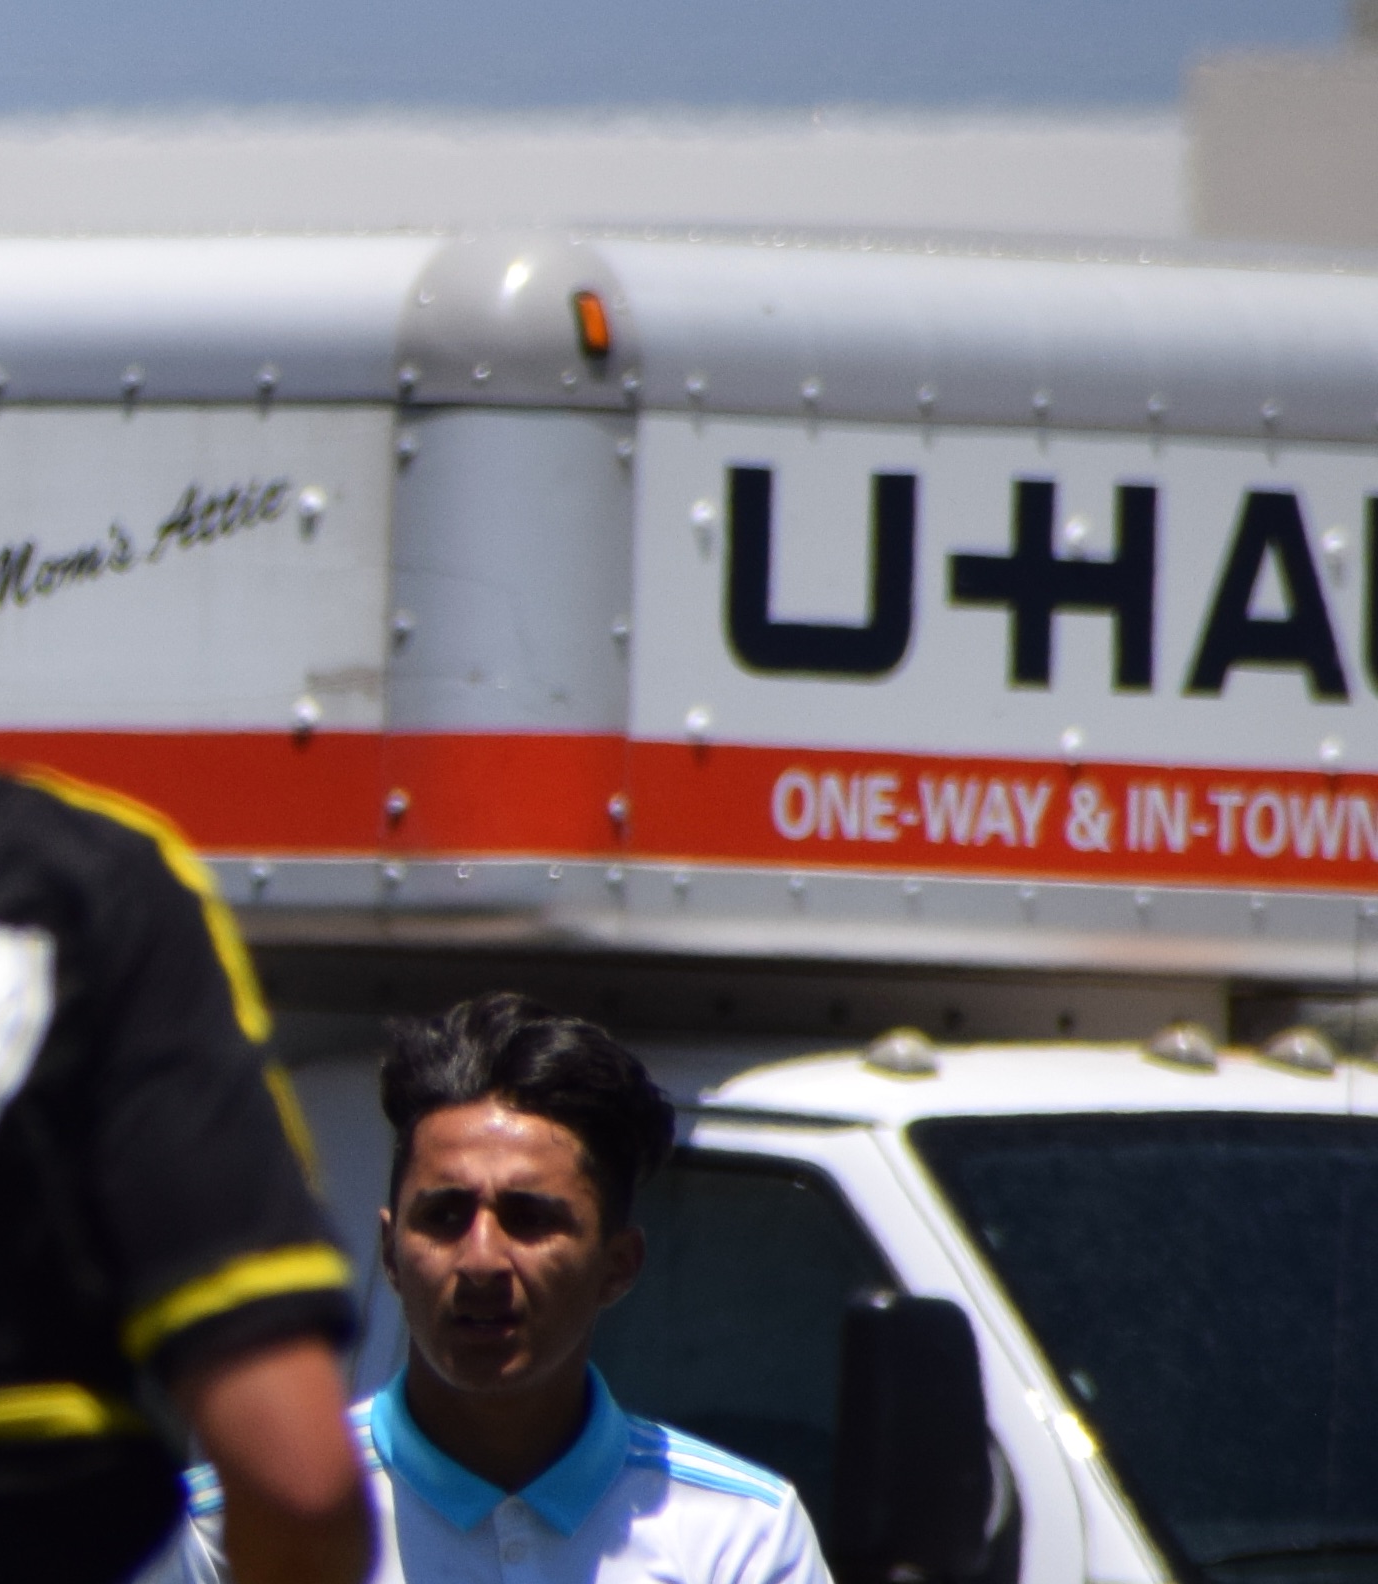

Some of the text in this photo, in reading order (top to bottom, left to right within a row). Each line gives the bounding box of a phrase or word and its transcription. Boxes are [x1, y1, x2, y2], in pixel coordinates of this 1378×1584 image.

[147, 480, 289, 563] Attic
[723, 464, 1378, 706] U-HA
[771, 767, 1051, 850] ONE-WAY
[1063, 782, 1113, 854] &
